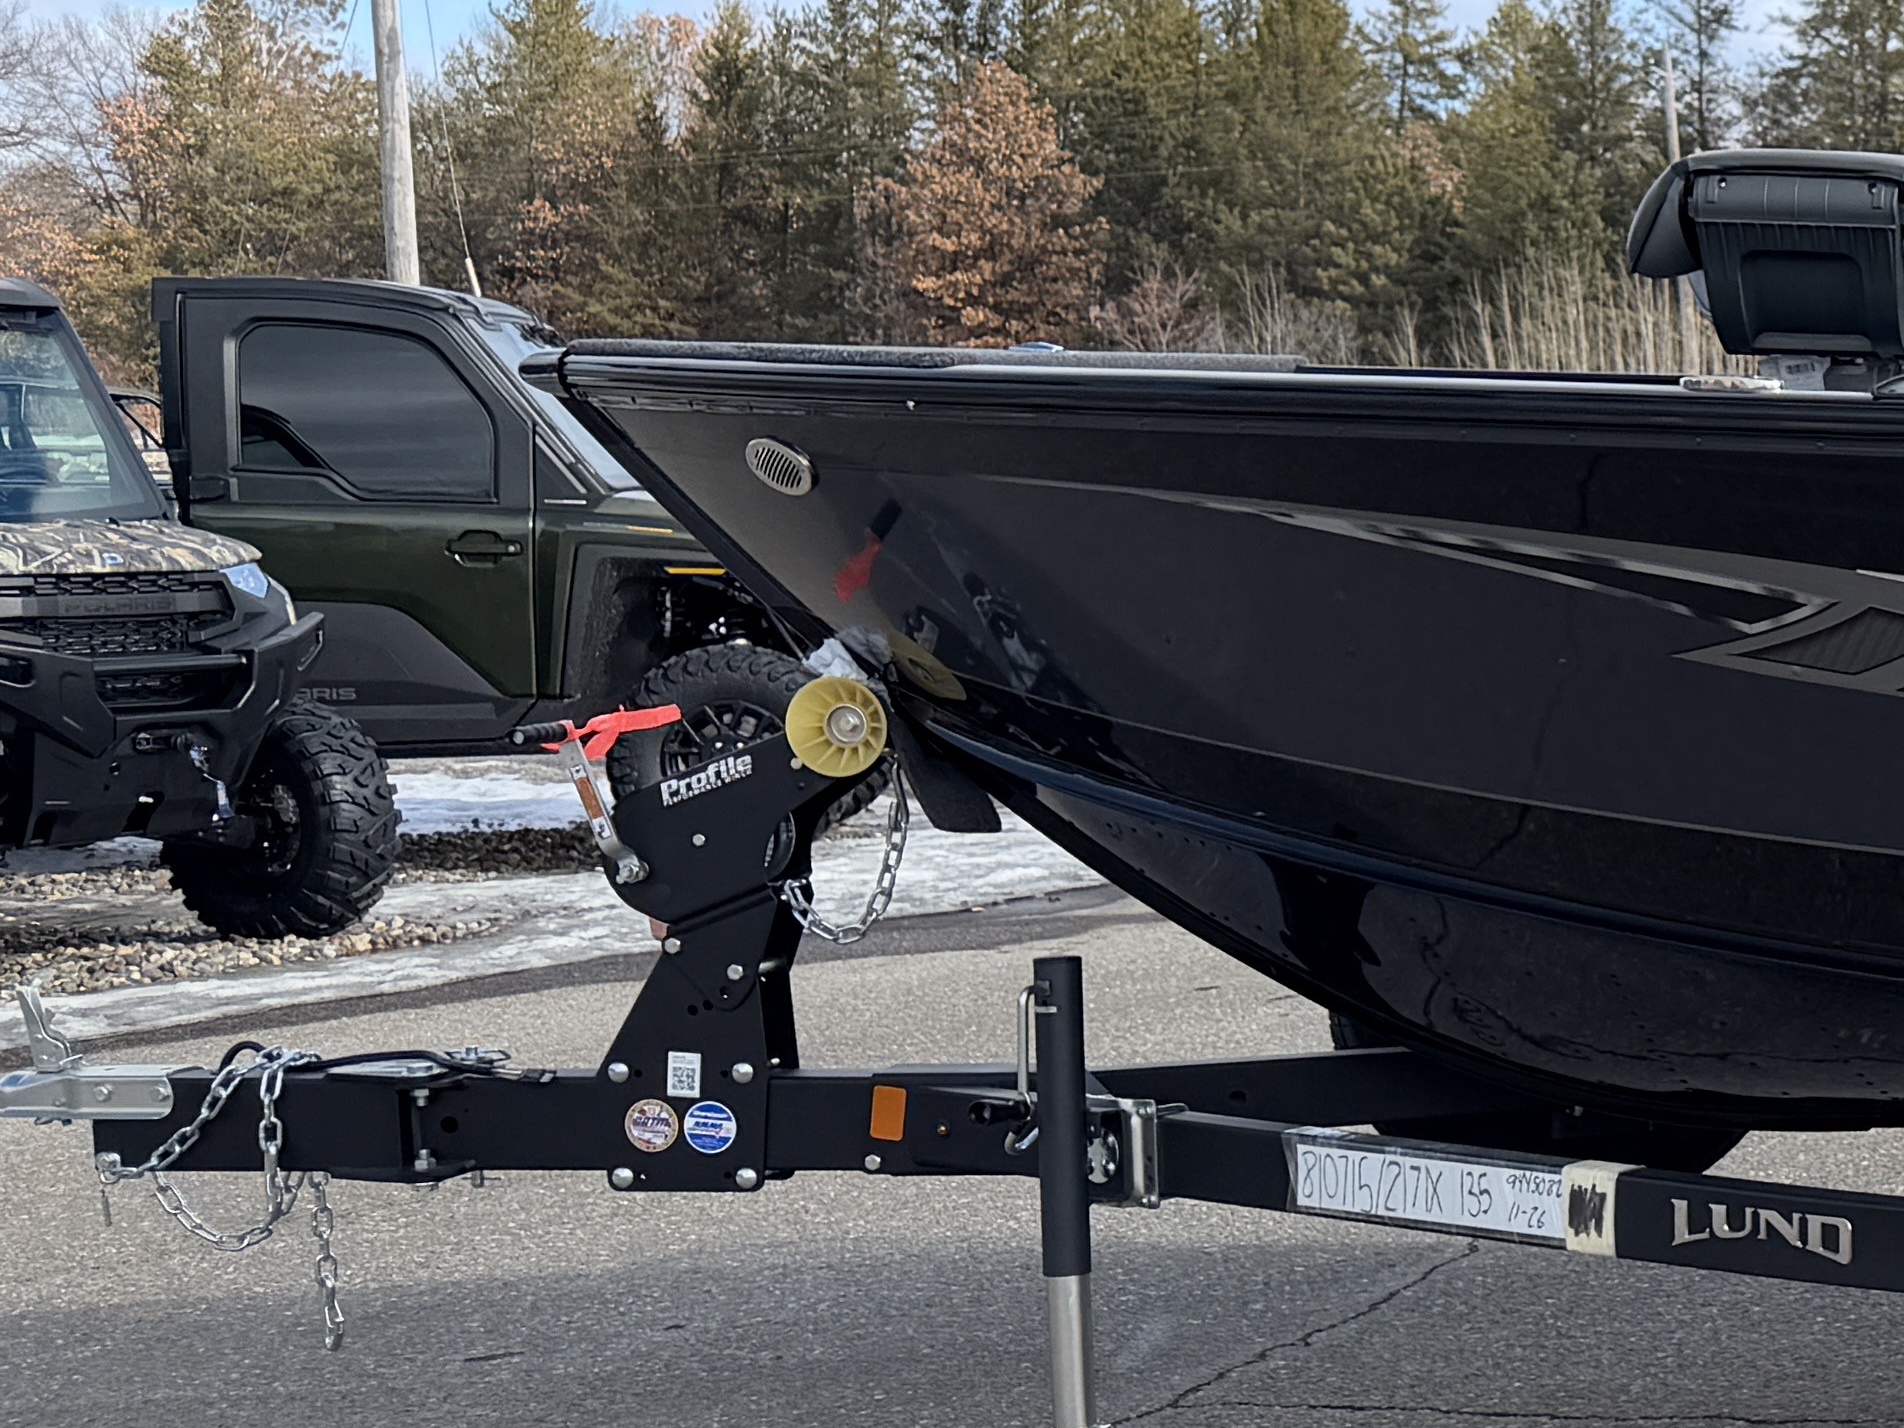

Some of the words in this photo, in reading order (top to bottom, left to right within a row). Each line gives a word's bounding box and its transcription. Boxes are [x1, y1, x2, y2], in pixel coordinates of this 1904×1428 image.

[660, 755, 753, 803] Profile
[1461, 1168, 1493, 1218] 135
[1671, 1197, 1853, 1266] LUND
